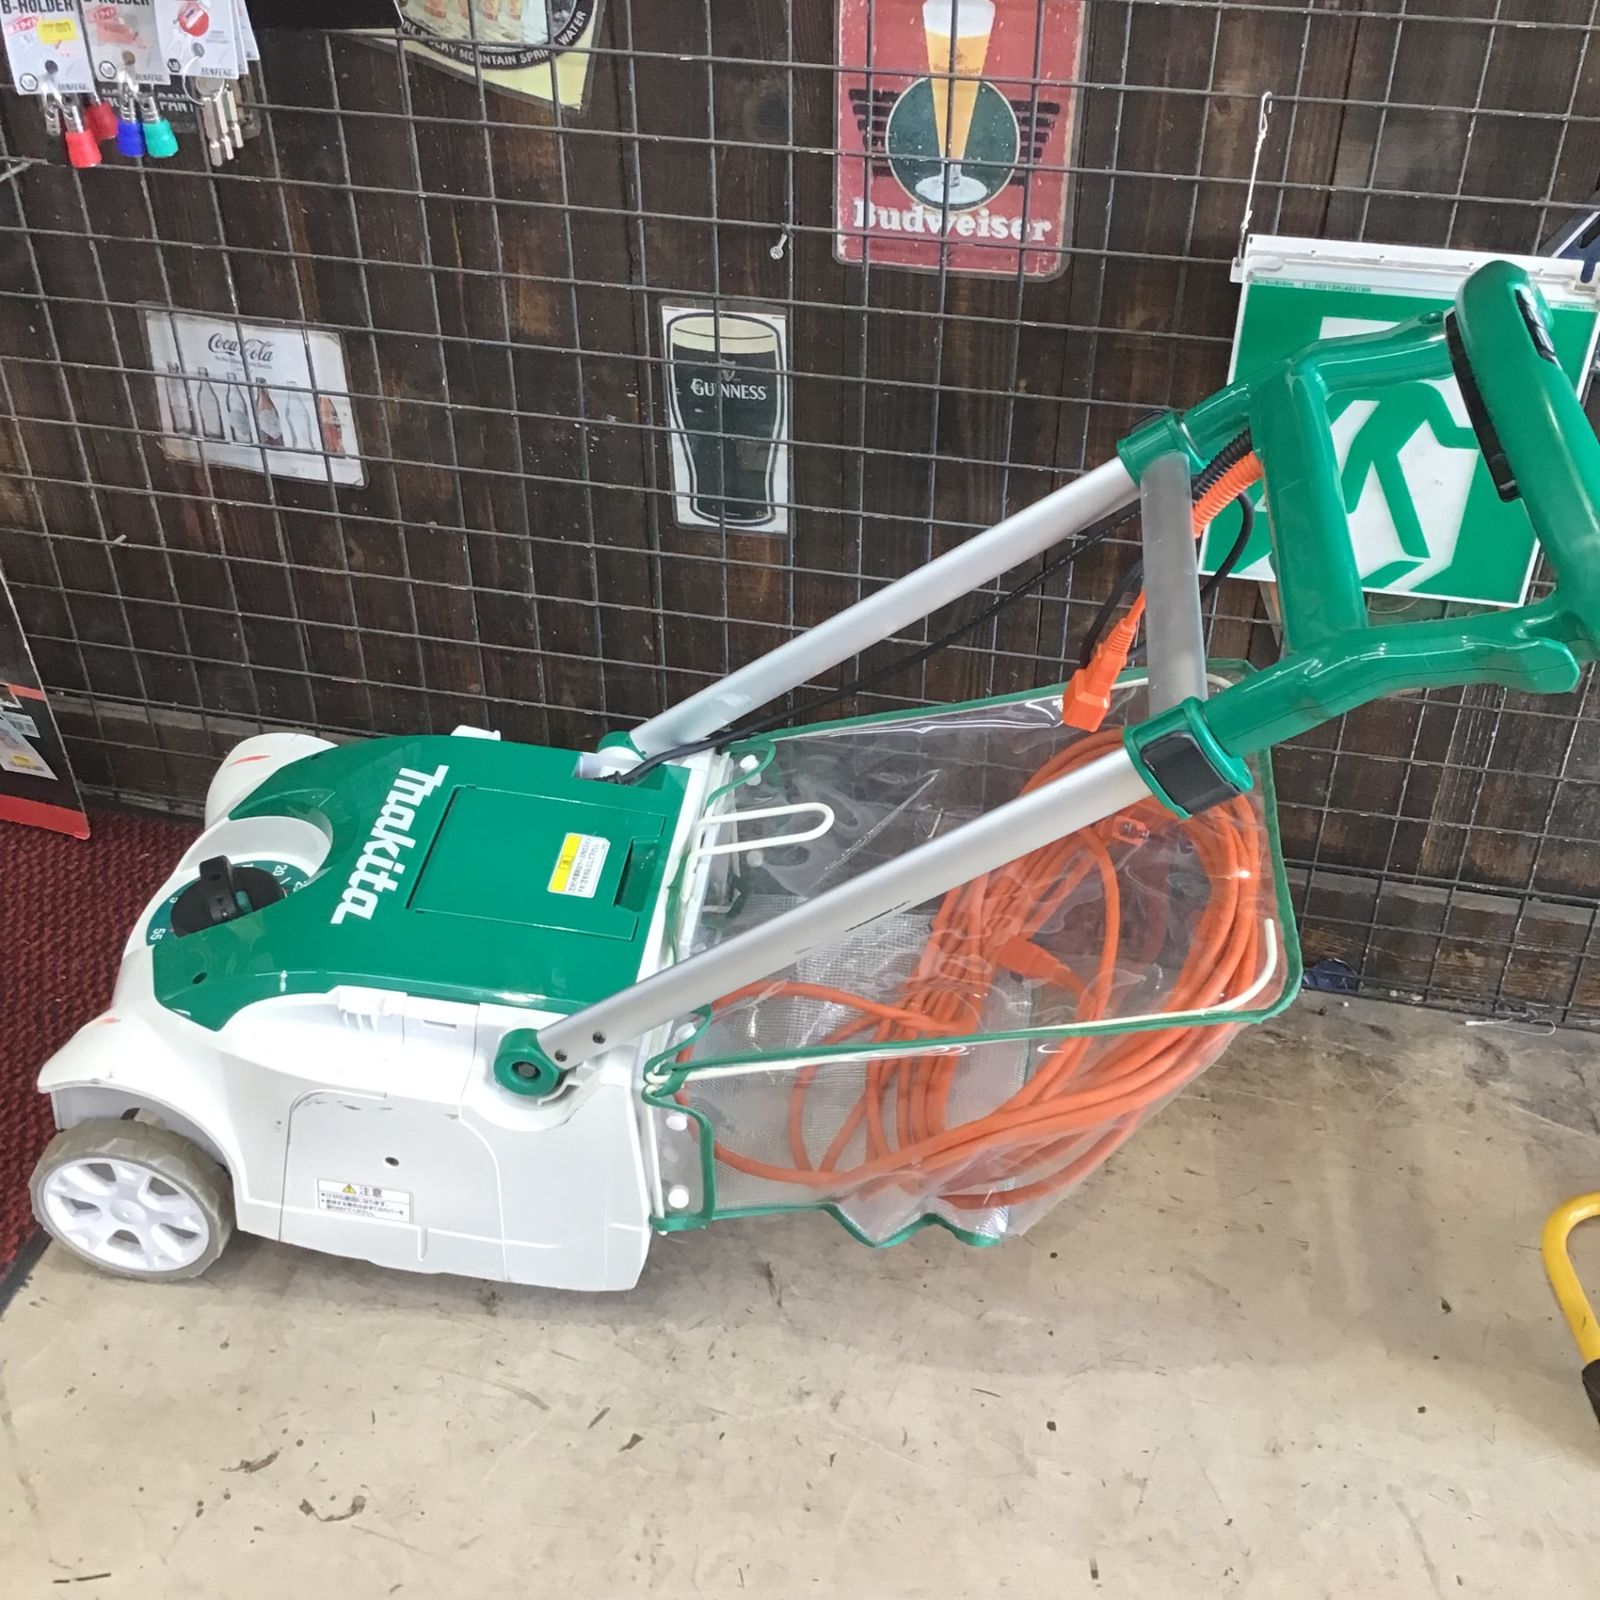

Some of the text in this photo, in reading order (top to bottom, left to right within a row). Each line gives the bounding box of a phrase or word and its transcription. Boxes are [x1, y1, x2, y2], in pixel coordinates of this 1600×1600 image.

[459, 48, 516, 66] MOUNTAIN
[558, 11, 587, 45] WATER
[852, 197, 1053, 241] Budweiser
[690, 377, 767, 401] GUNNESS
[272, 864, 288, 877] 20
[149, 927, 167, 941] 55
